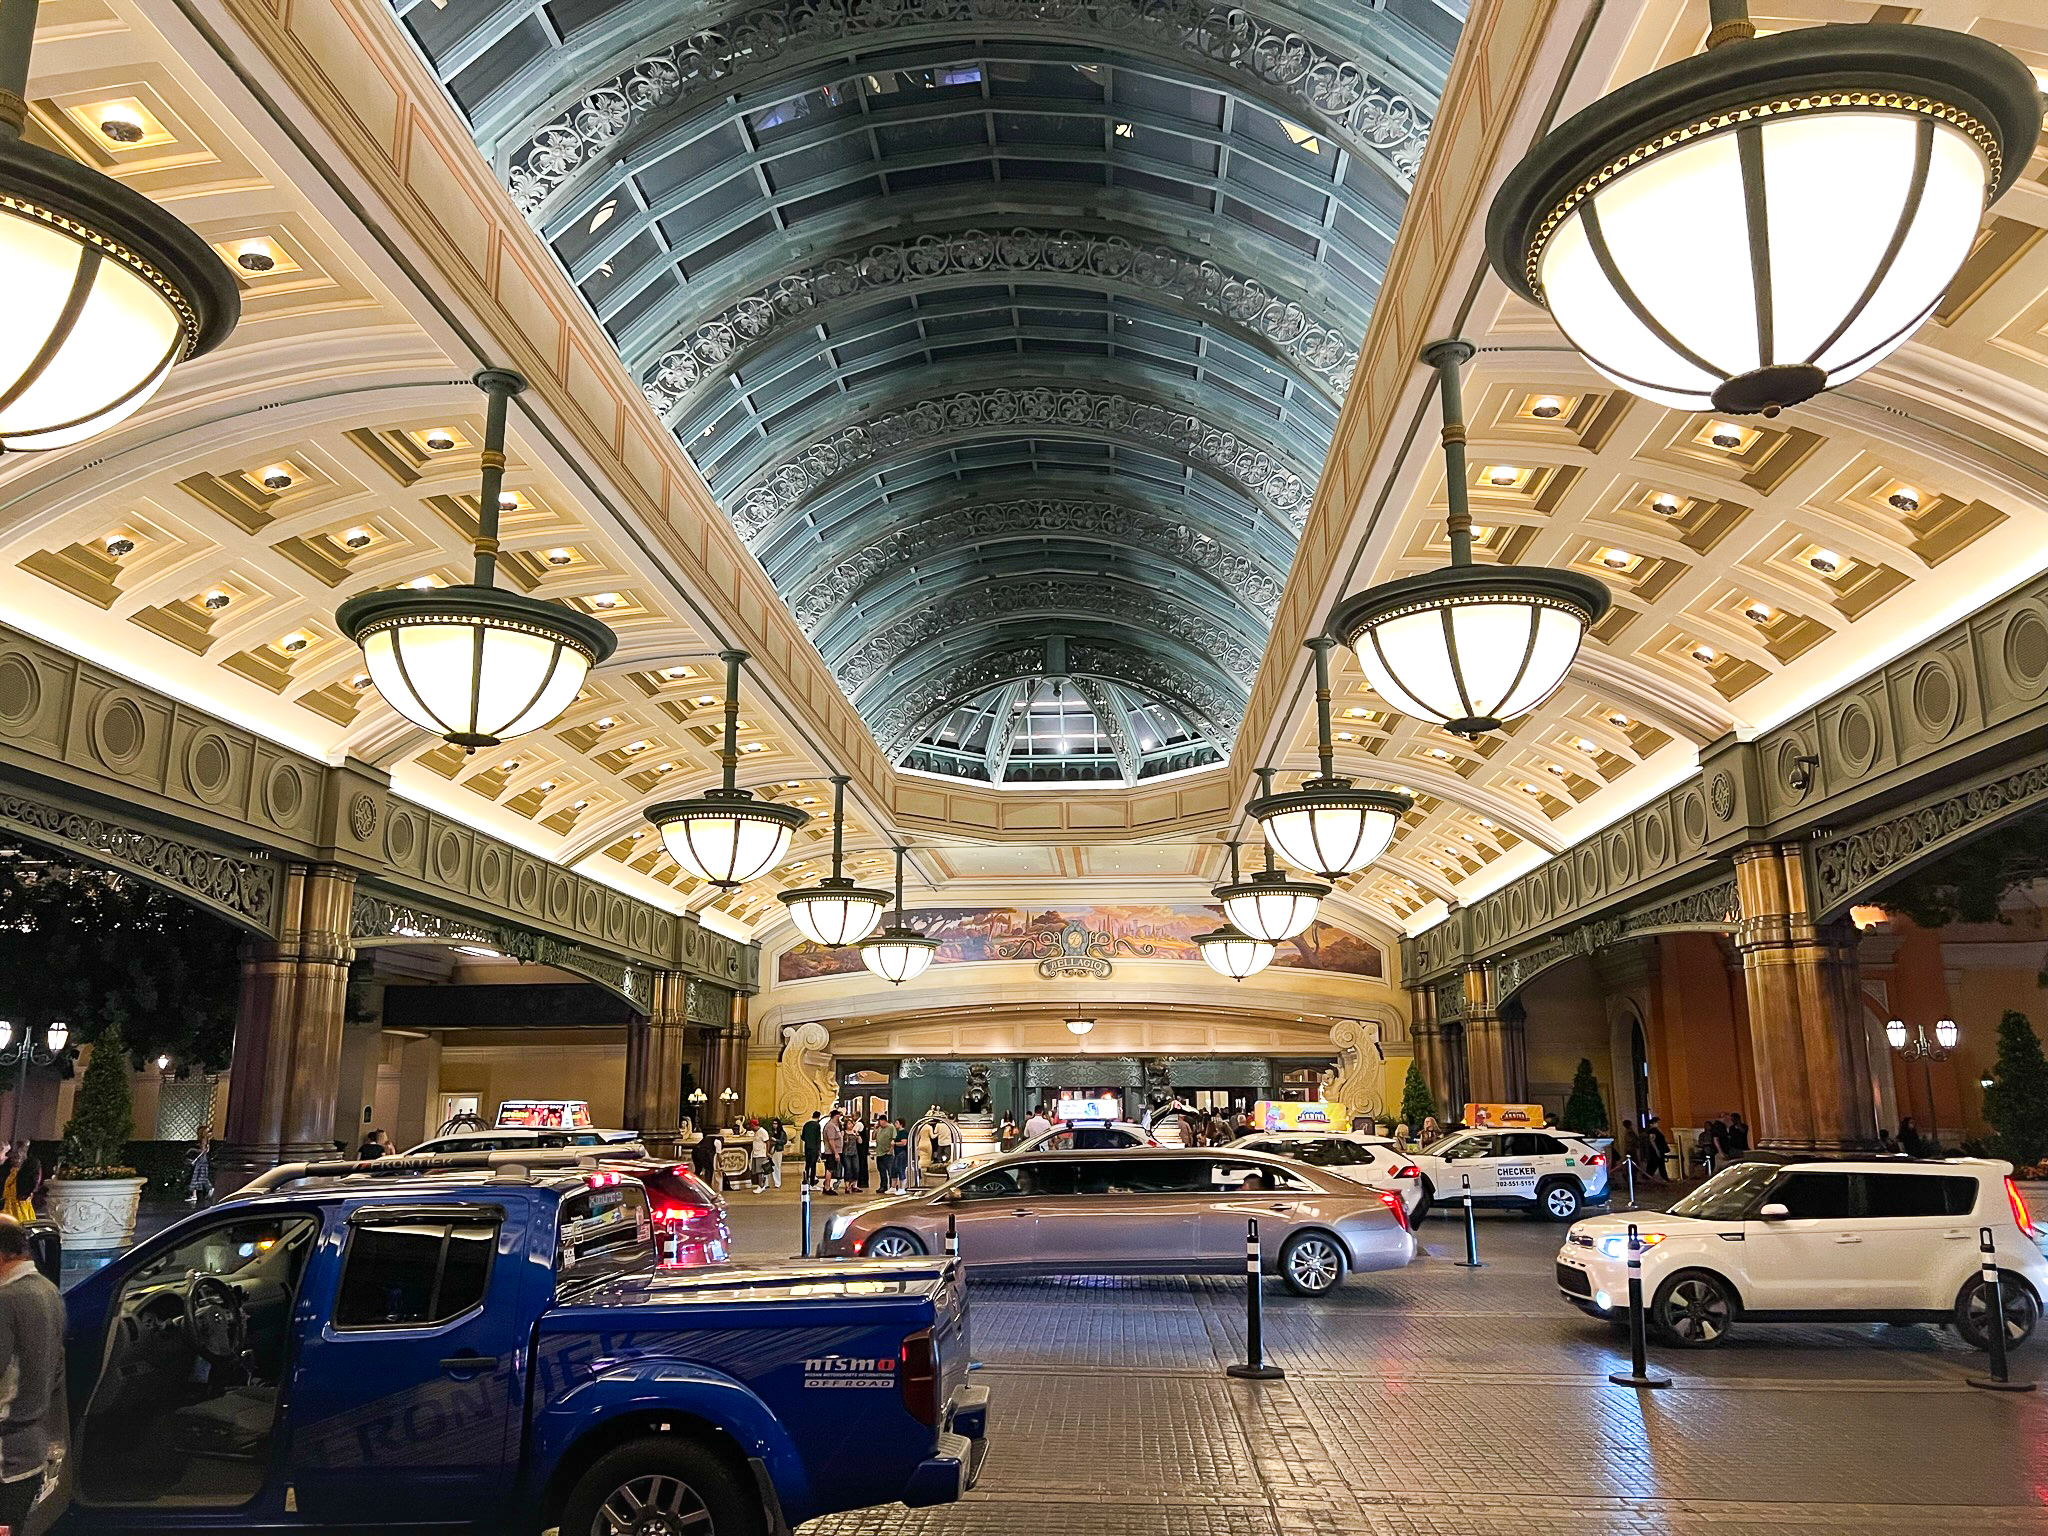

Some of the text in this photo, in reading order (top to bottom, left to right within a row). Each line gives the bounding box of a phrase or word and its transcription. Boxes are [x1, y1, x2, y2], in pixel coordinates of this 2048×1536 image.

[1051, 958, 1101, 969] BELLAGIO
[370, 1157, 454, 1169] FRONTIER
[1497, 1167, 1537, 1176] CHECKER
[804, 1358, 896, 1371] nismo
